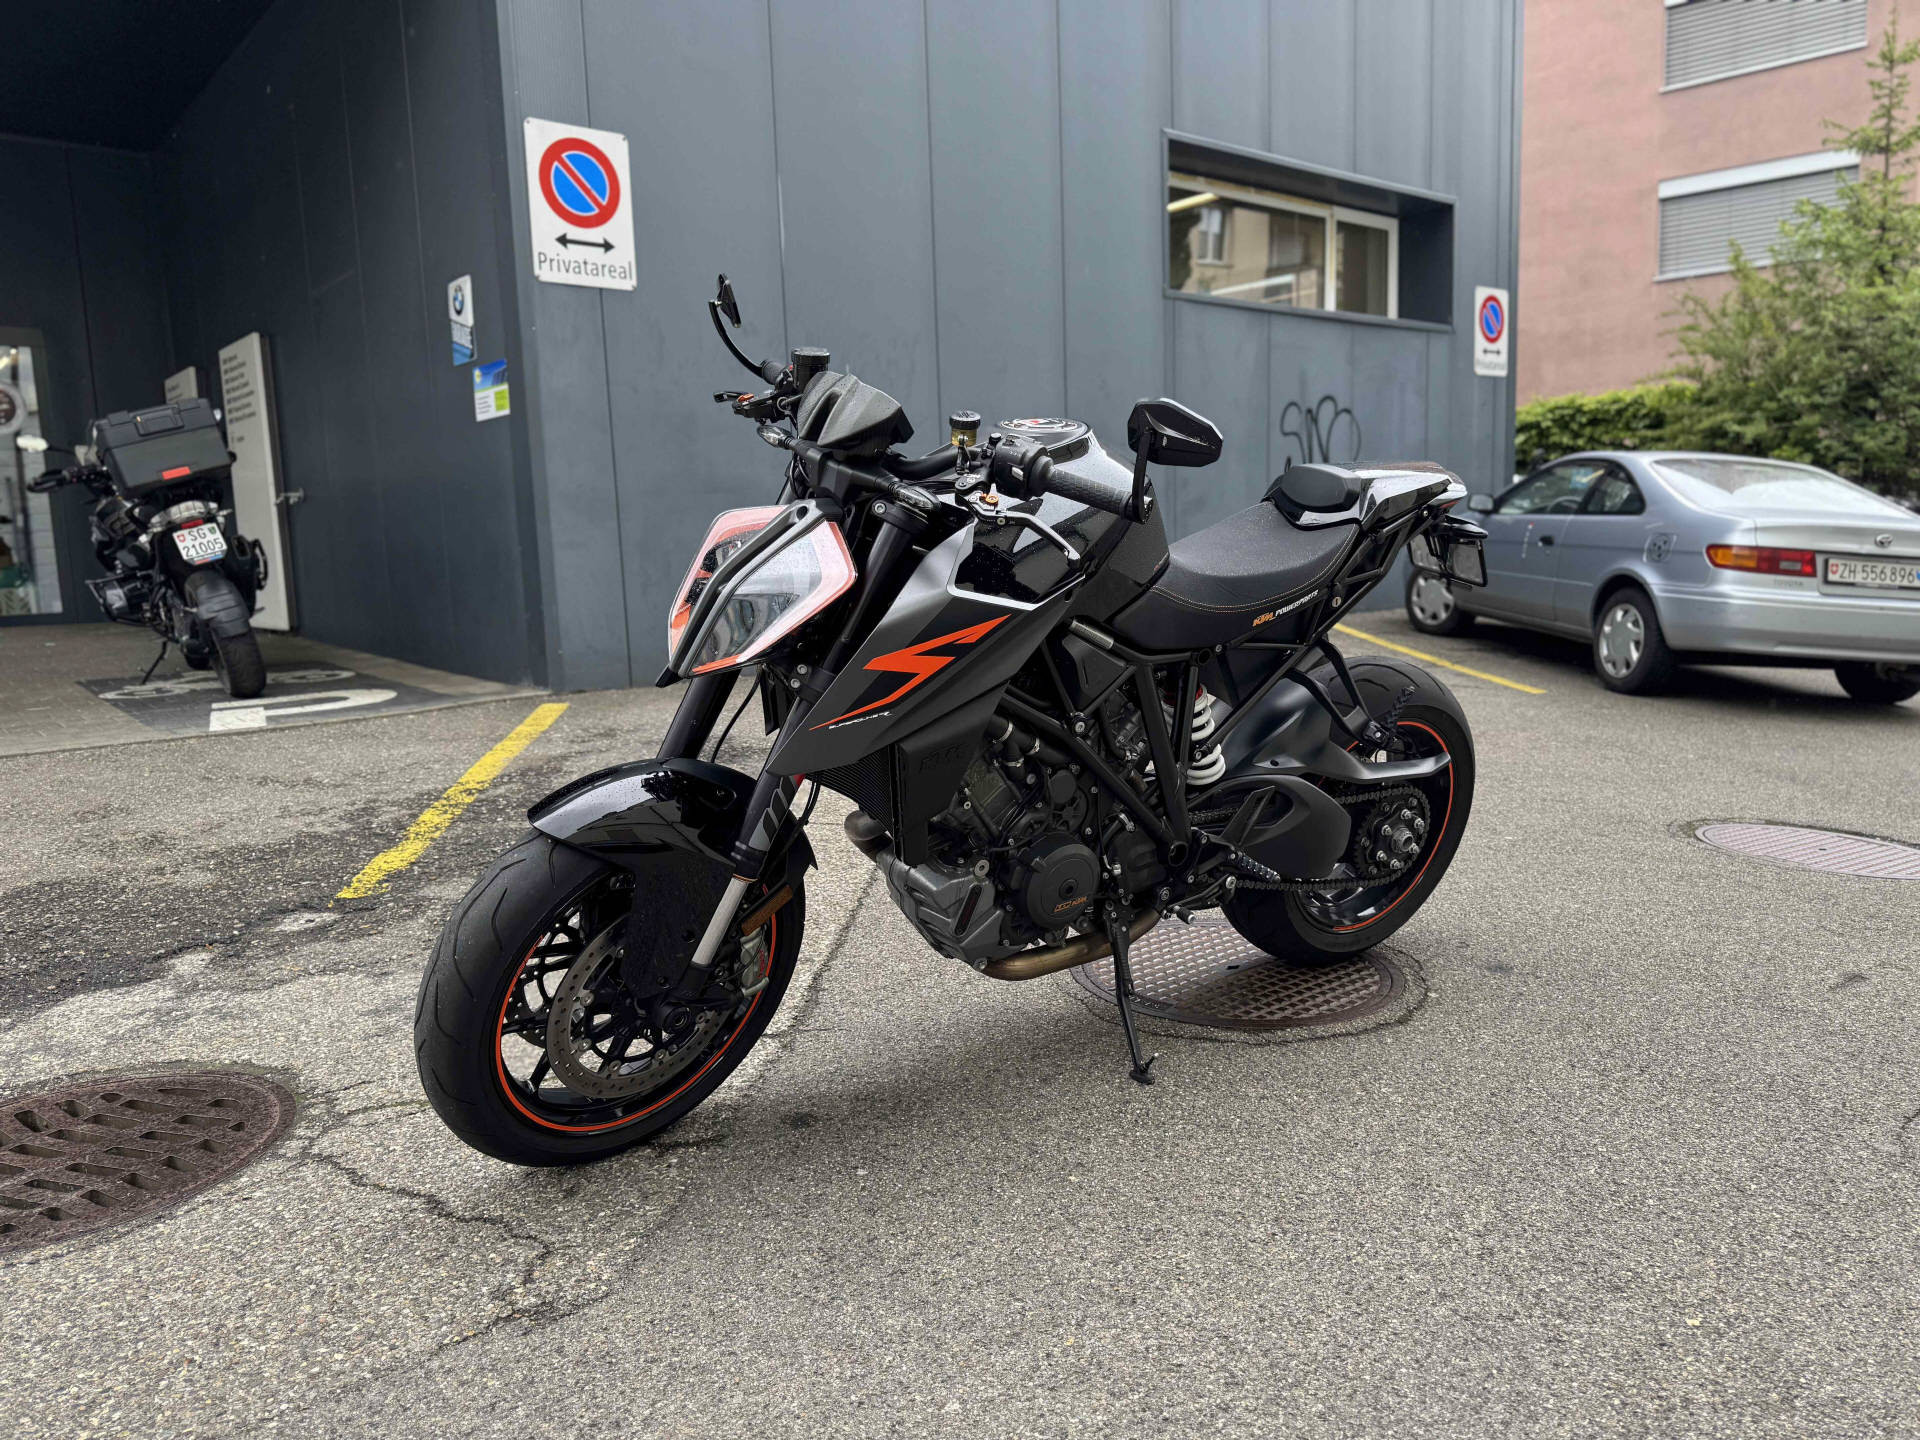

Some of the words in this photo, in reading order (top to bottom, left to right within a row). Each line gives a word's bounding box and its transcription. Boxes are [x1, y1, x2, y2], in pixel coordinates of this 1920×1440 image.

[538, 251, 633, 281] Privatareal
[187, 527, 207, 542] SG
[182, 537, 224, 558] 21005
[1839, 562, 1857, 580] ZH
[1861, 564, 1916, 584] 556896
